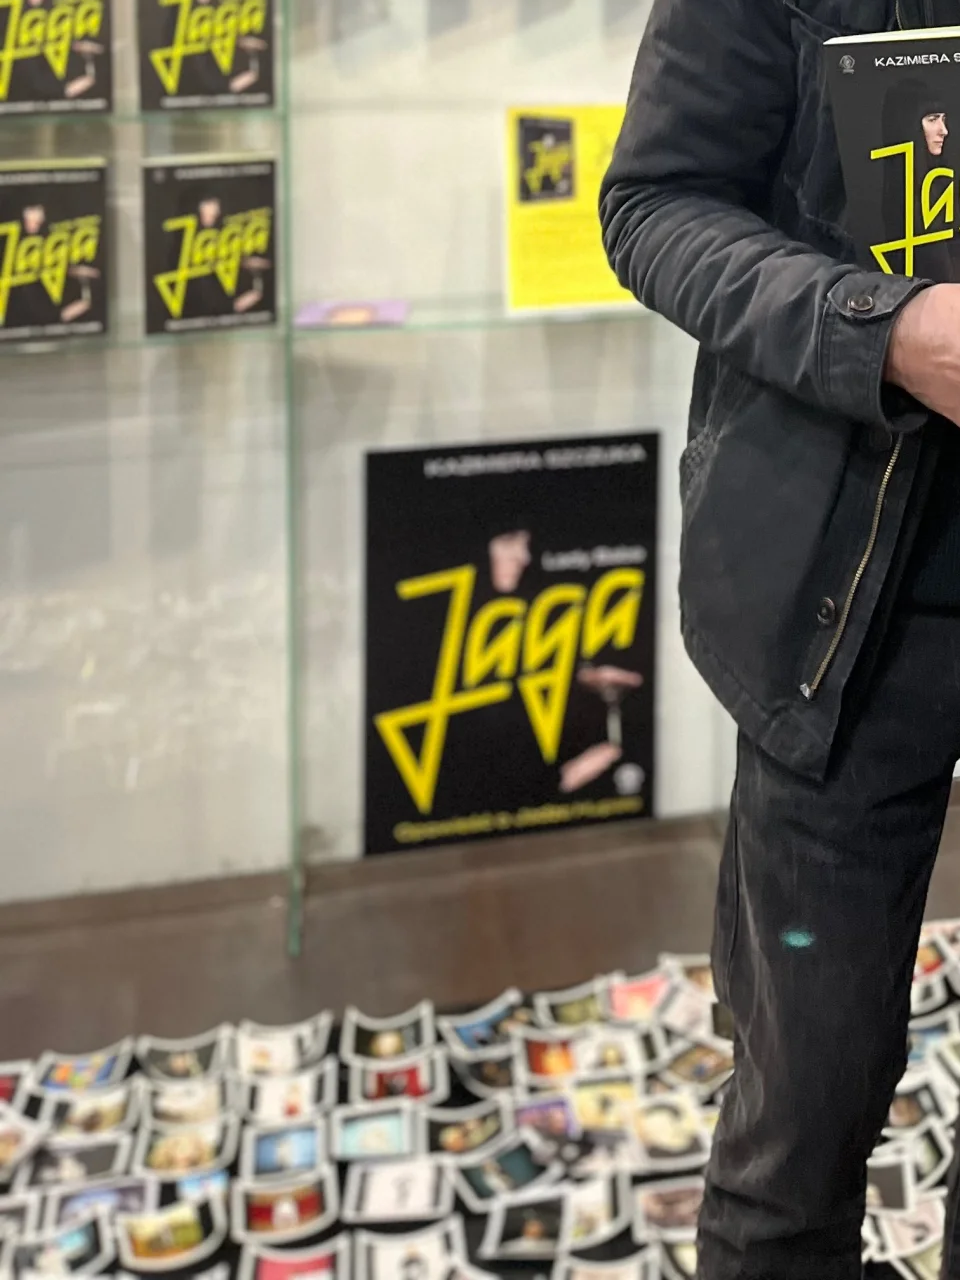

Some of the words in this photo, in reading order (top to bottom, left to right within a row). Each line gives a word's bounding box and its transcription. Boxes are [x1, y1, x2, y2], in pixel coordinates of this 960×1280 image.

[875, 53, 950, 67] KAZIMIERA
[153, 208, 270, 318] Jaga
[374, 565, 645, 814] Jaga
